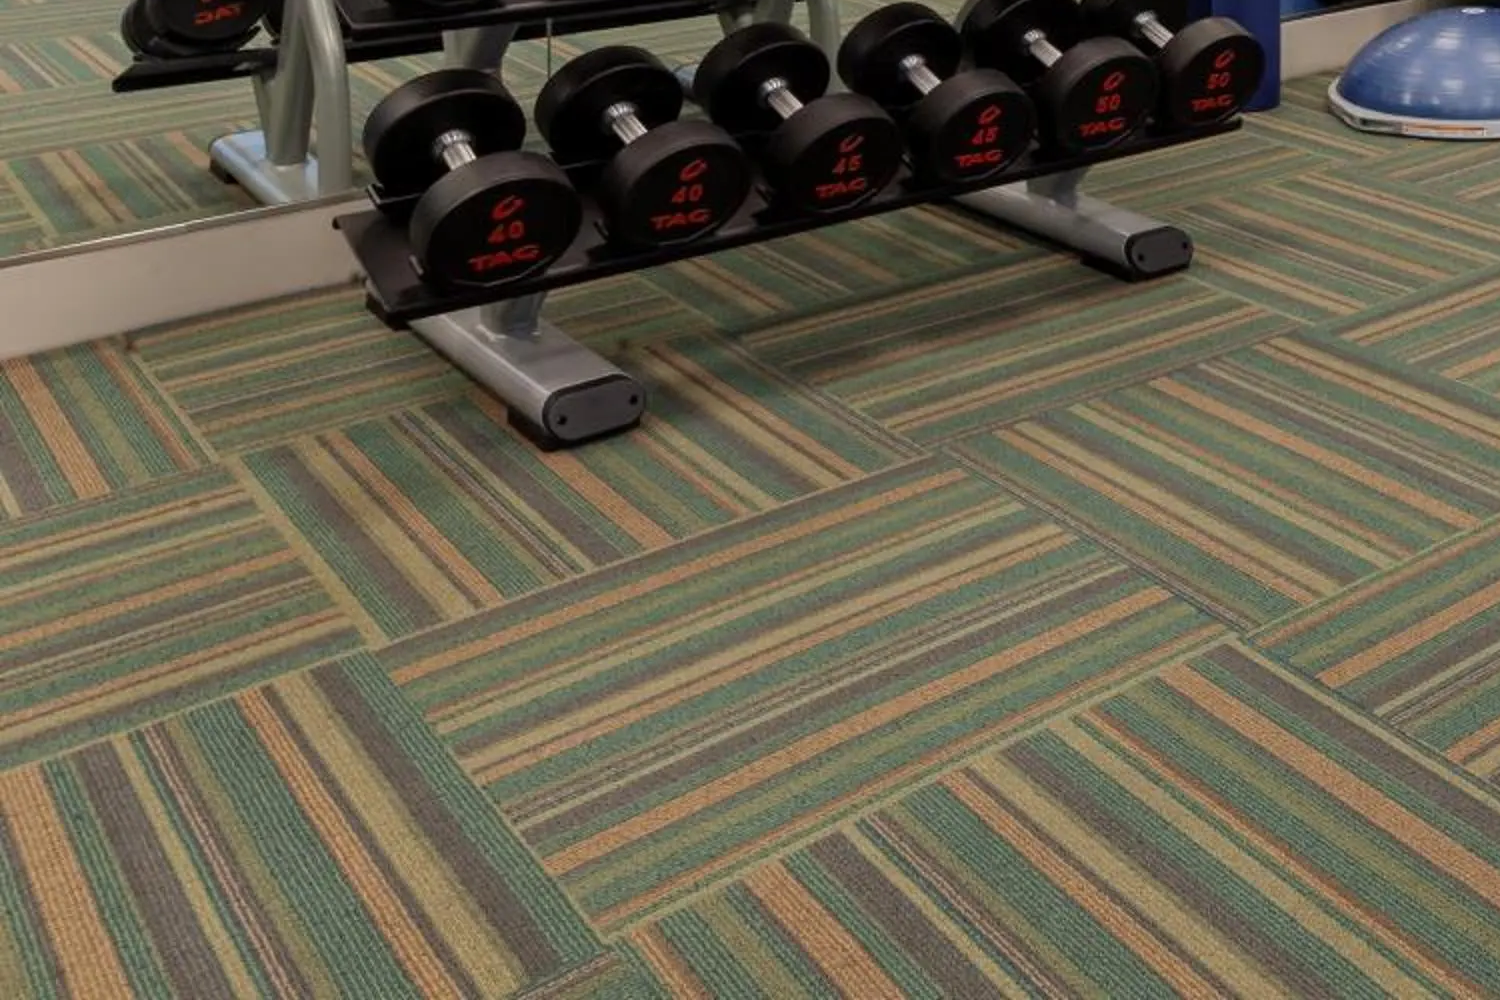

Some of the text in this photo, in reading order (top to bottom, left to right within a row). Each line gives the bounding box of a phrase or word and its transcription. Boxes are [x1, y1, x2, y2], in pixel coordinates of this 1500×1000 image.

[1207, 72, 1229, 88] 50
[1095, 95, 1120, 112] 50
[1192, 93, 1232, 111] TAG
[972, 126, 997, 145] 45
[1079, 117, 1126, 136] TAG
[833, 154, 862, 174] 45
[956, 149, 1003, 168] TAG
[672, 183, 704, 203] 40
[816, 177, 865, 198] TAG
[650, 209, 710, 230] TAG
[487, 222, 523, 245] 40
[469, 244, 540, 271] TAG
